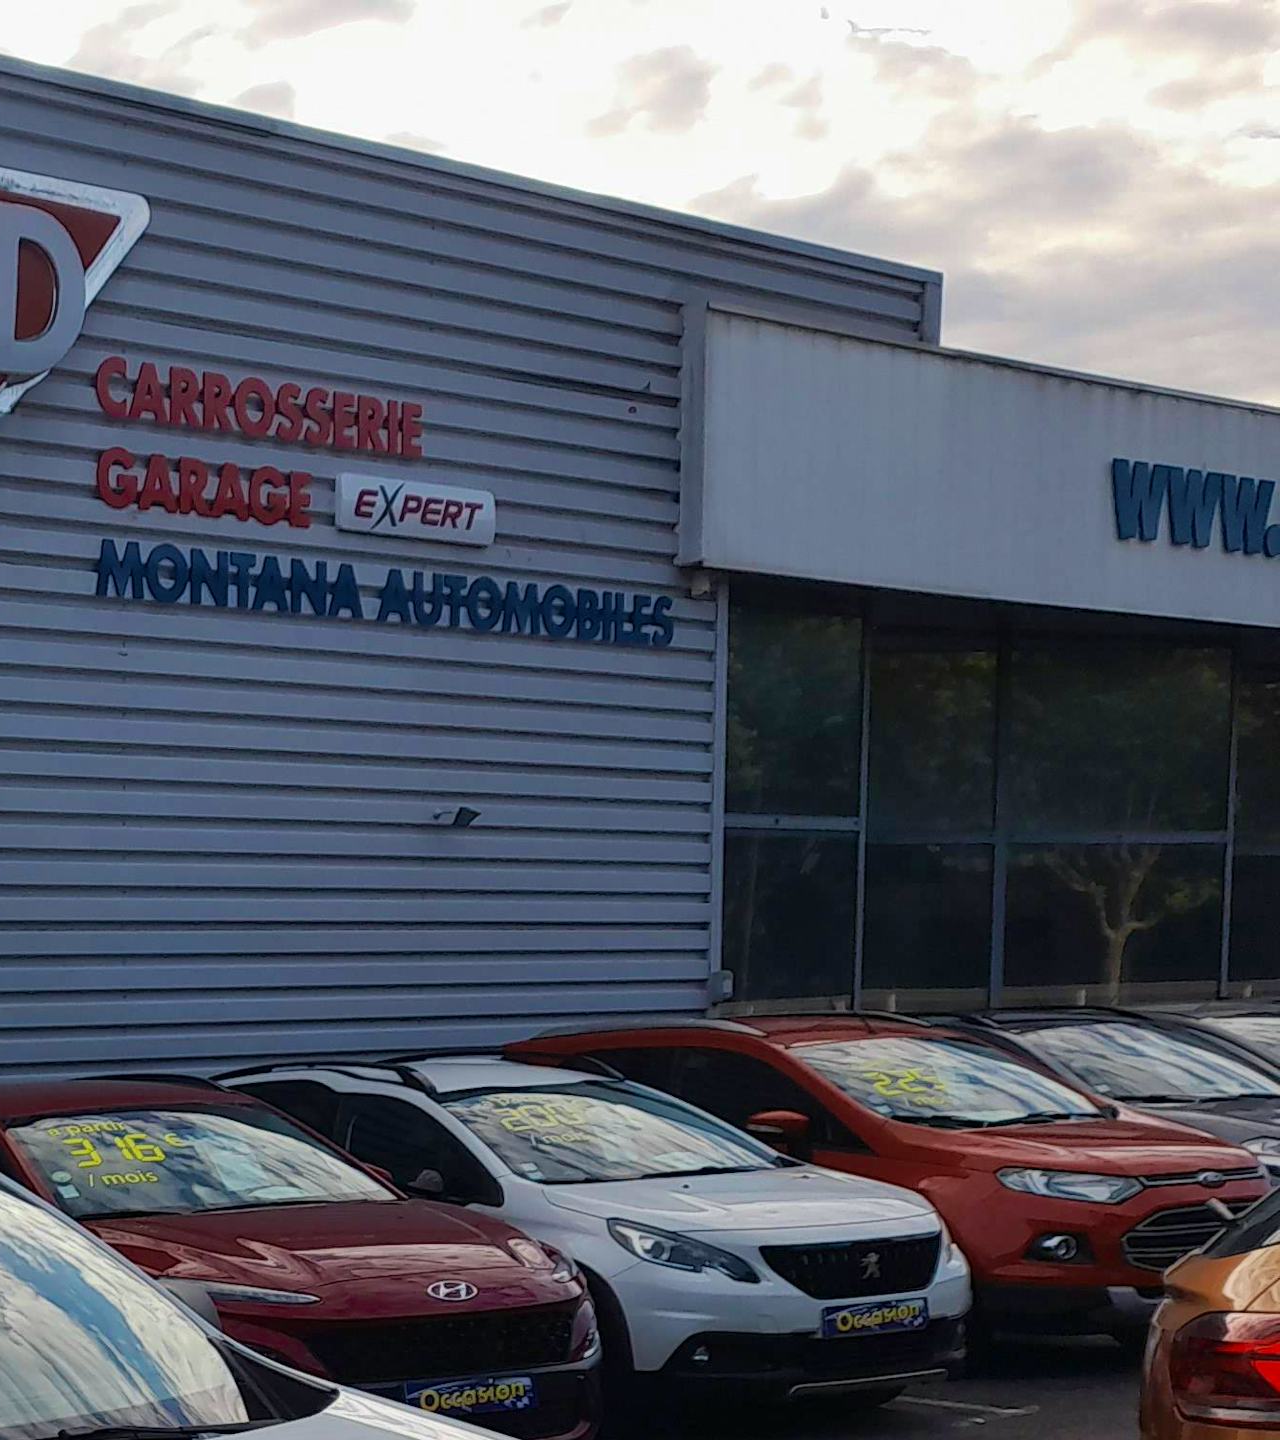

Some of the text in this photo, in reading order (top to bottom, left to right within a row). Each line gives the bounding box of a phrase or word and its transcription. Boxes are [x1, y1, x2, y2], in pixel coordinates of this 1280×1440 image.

[95, 356, 423, 460] CARROSSERIE
[97, 447, 313, 528] GARAGE
[354, 482, 484, 531] EXPERT
[96, 538, 675, 648] MONTANA AUTOMOBILES
[100, 1170, 159, 1185] mois
[836, 1301, 919, 1332] Occasion
[419, 1377, 525, 1412] Occasion
